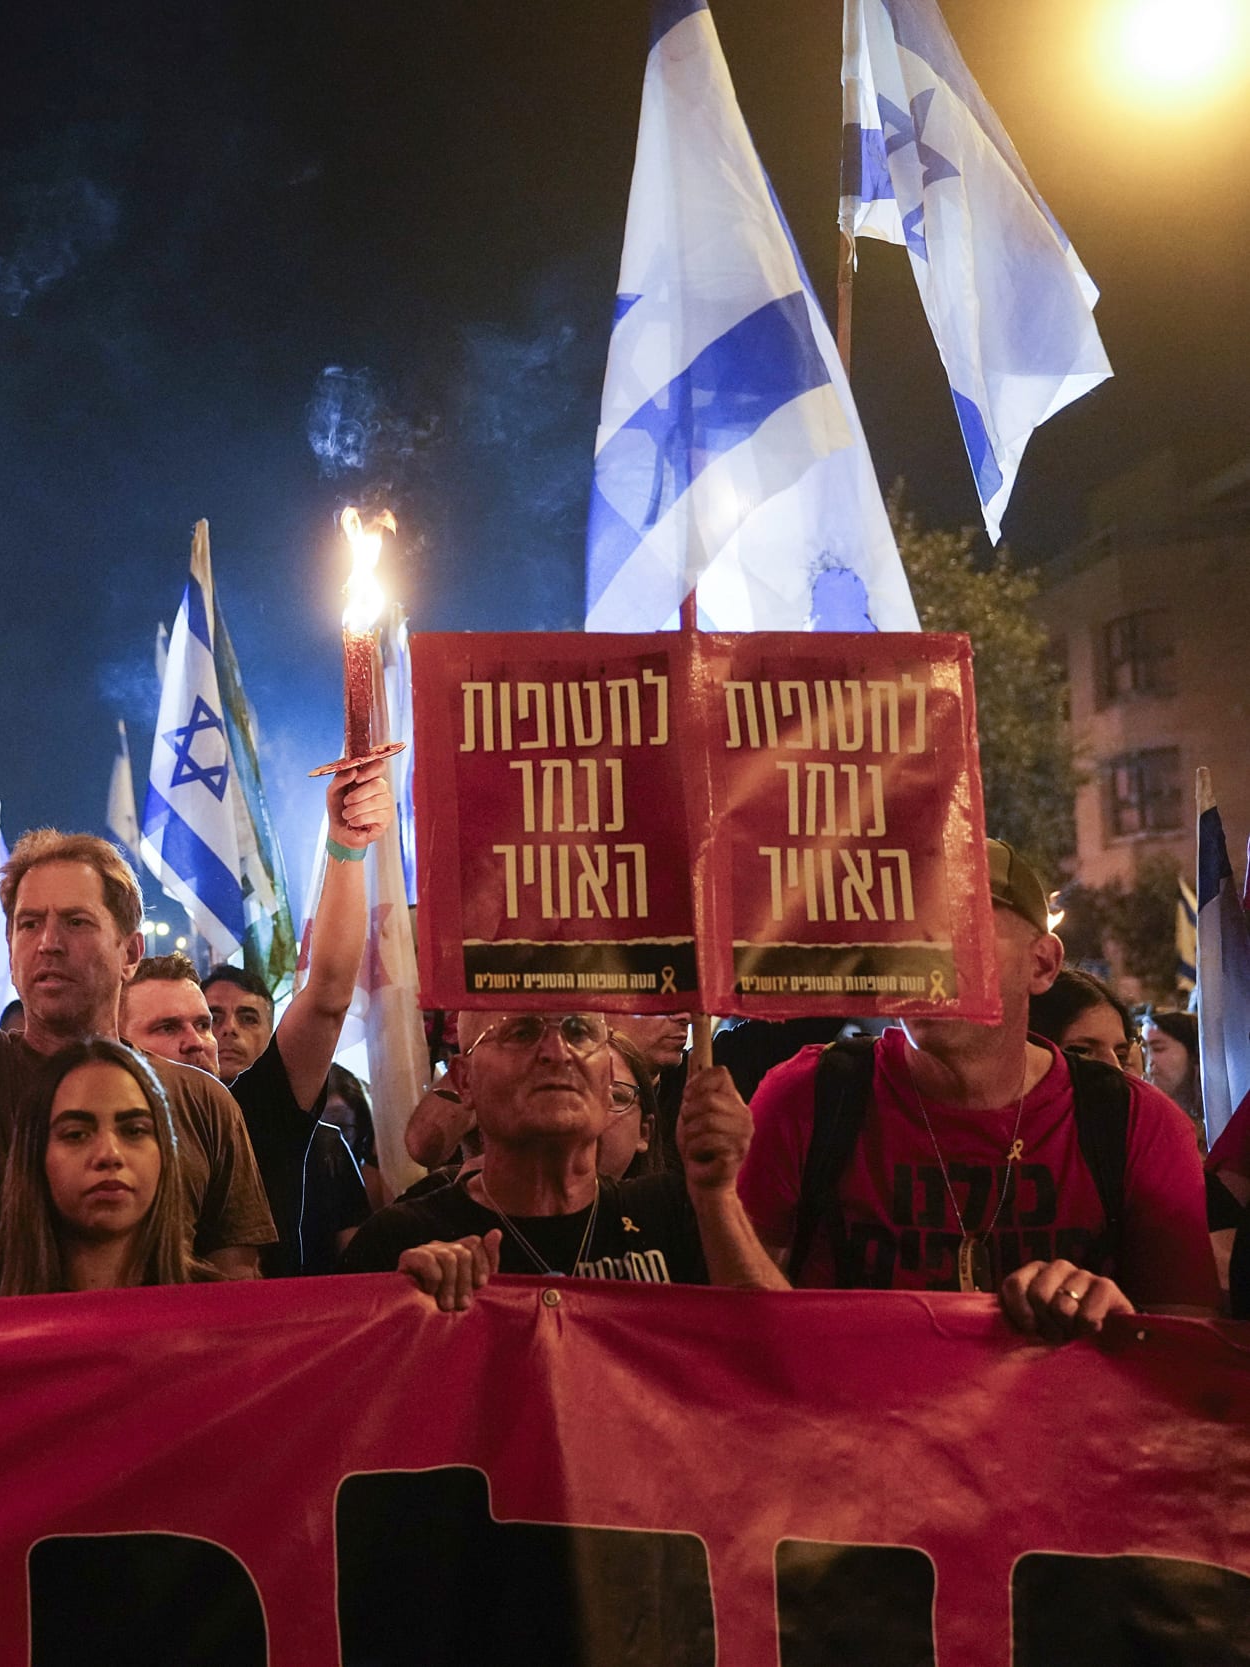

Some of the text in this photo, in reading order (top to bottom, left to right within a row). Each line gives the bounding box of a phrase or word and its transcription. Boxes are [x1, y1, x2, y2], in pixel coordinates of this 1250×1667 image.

[460, 668, 669, 752] לחטופות
[722, 673, 927, 753] לחטופות
[509, 758, 625, 832] נגמר
[776, 761, 887, 837] נגמר
[493, 843, 648, 919] האוויר
[758, 846, 915, 921] האוויר
[475, 972, 520, 989] ירושלים
[523, 973, 575, 989] החטופים
[630, 973, 657, 989] מטה
[893, 1162, 1057, 1229] כולנו
